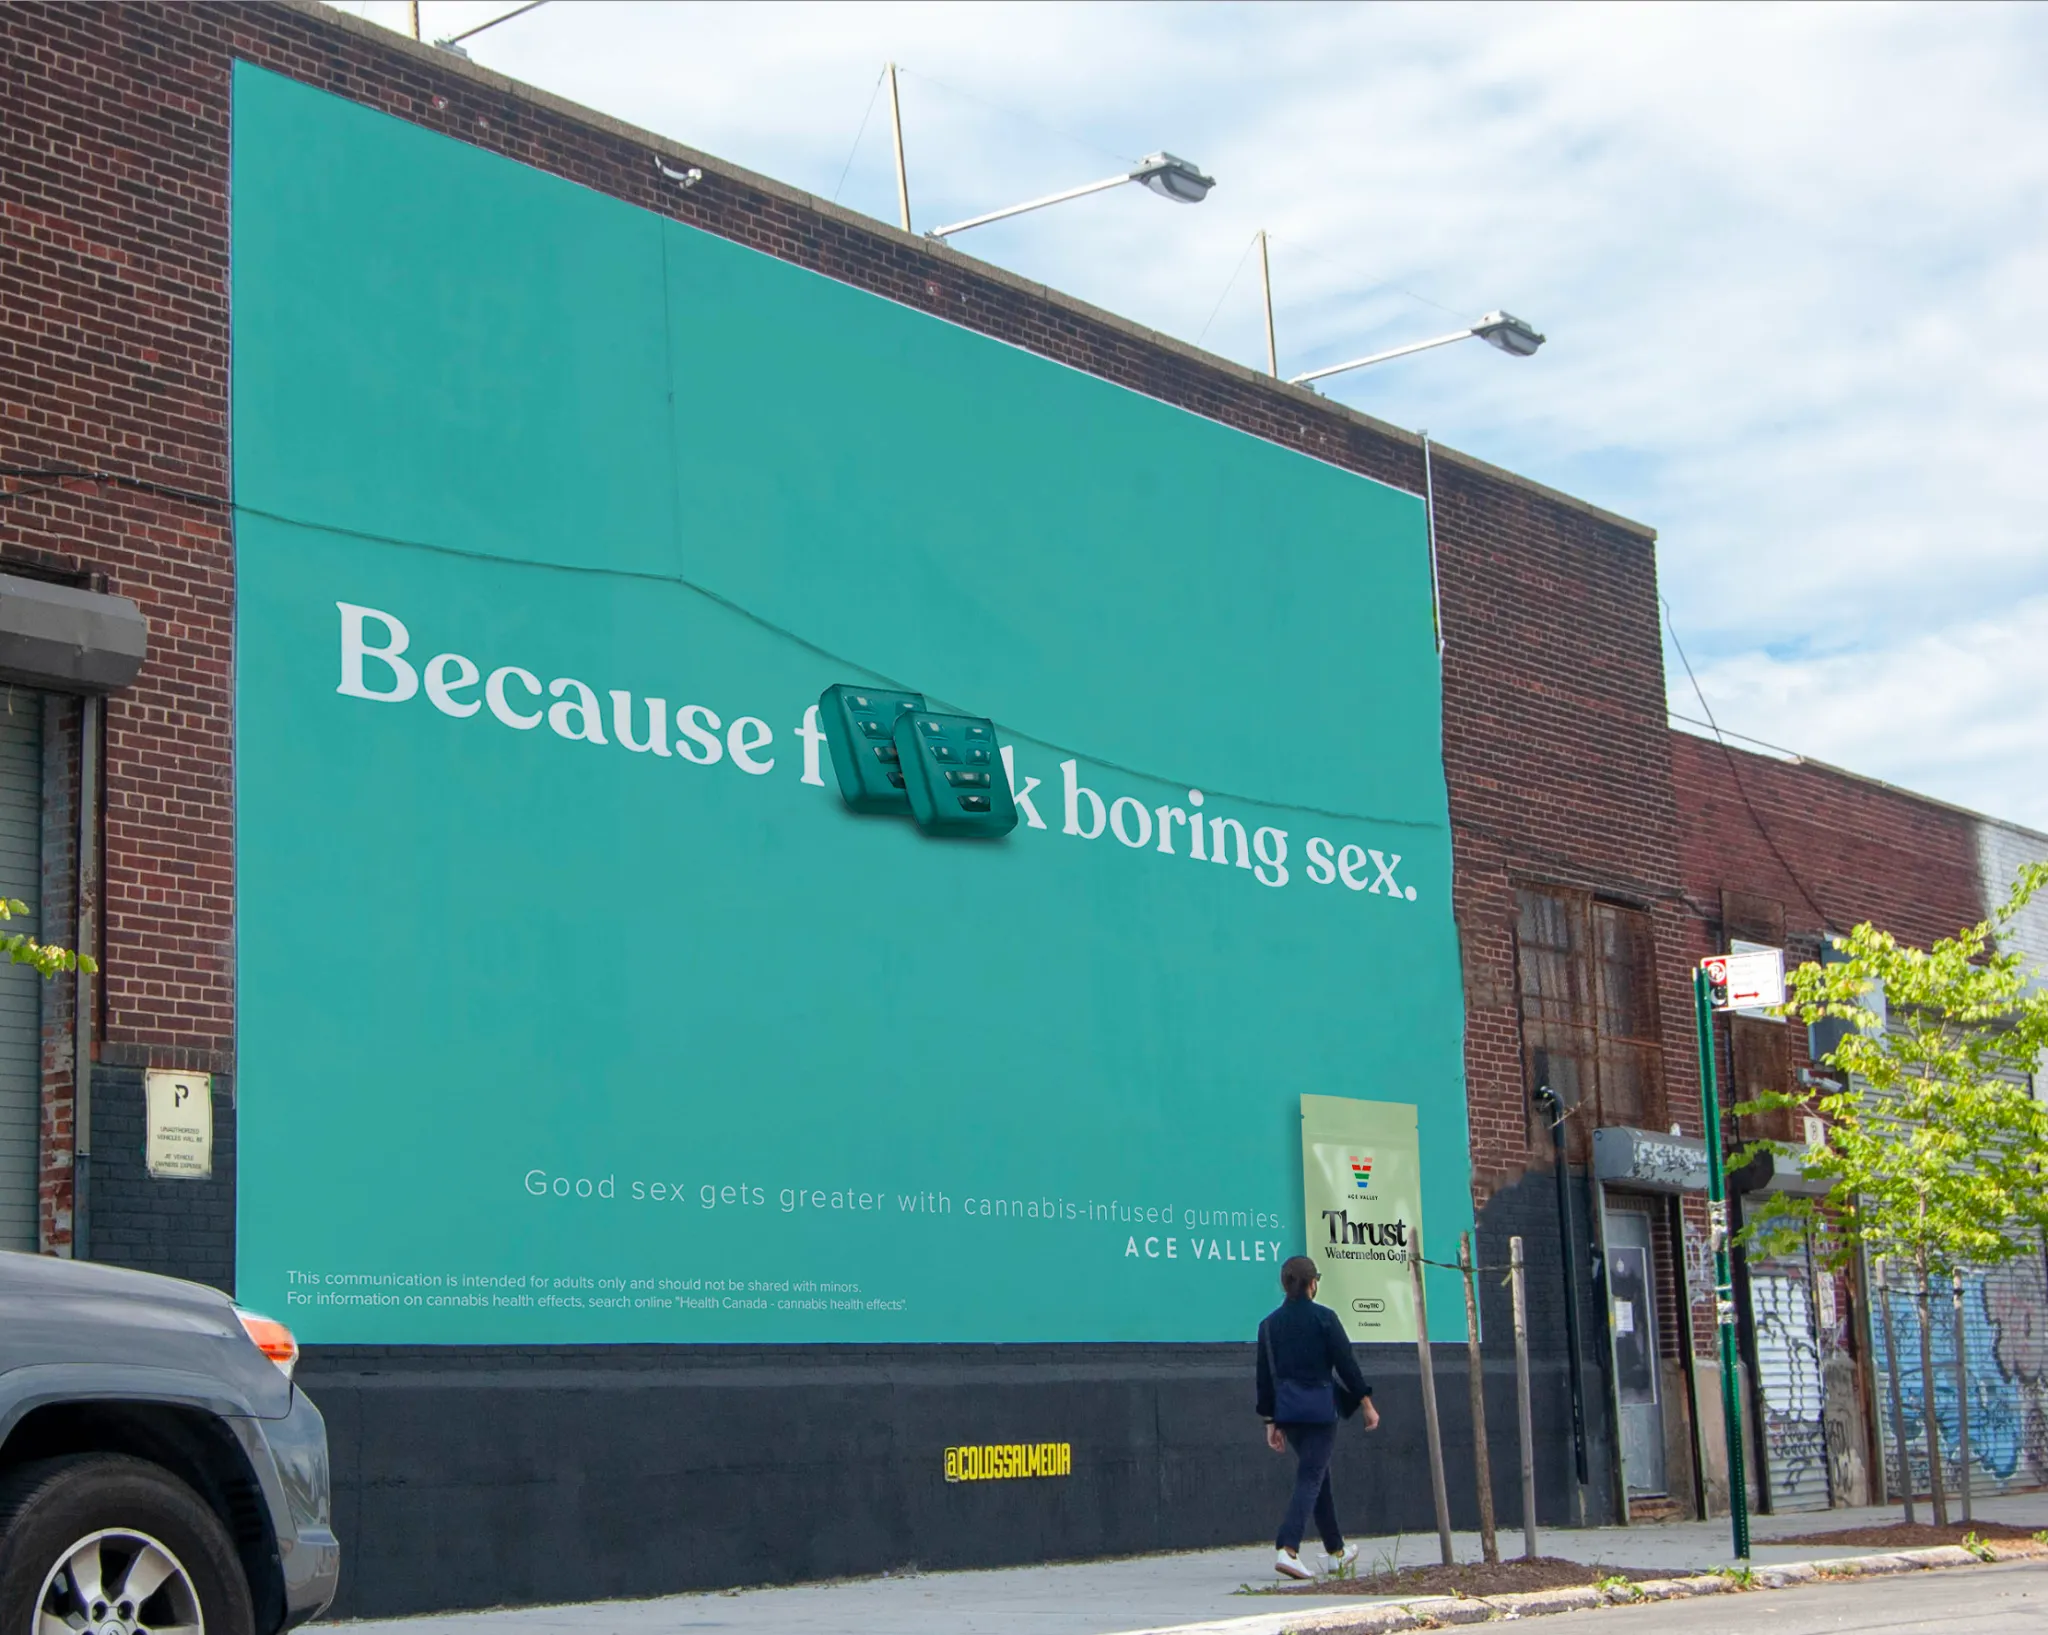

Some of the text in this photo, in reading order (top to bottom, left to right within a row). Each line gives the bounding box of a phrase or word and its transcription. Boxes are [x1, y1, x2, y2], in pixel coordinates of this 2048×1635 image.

[336, 601, 775, 775] Because
[1059, 758, 1290, 888] boring
[1305, 836, 1418, 902] sex.
[524, 1168, 1286, 1230] Good sex gets greater with cannabis-infused gummies.
[1321, 1209, 1407, 1247] Thrust
[1124, 1236, 1281, 1262] ACE VALLEY
[1325, 1246, 1407, 1264] Watermelon Goji
[286, 1270, 862, 1293] This communication is intended for adults only and should not be shared with minors.
[287, 1291, 312, 1304] For
[317, 1292, 400, 1305] information
[404, 1295, 423, 1305] on
[426, 1294, 489, 1307] cannabis
[493, 1294, 534, 1307] health
[538, 1294, 585, 1308] effects,
[589, 1296, 631, 1308] search
[635, 1296, 672, 1308] online
[722, 1297, 767, 1309] Canada
[777, 1298, 827, 1310] cannabis
[830, 1299, 863, 1310] health
[944, 1443, 1071, 1482] @COLOSSALMEDIA
